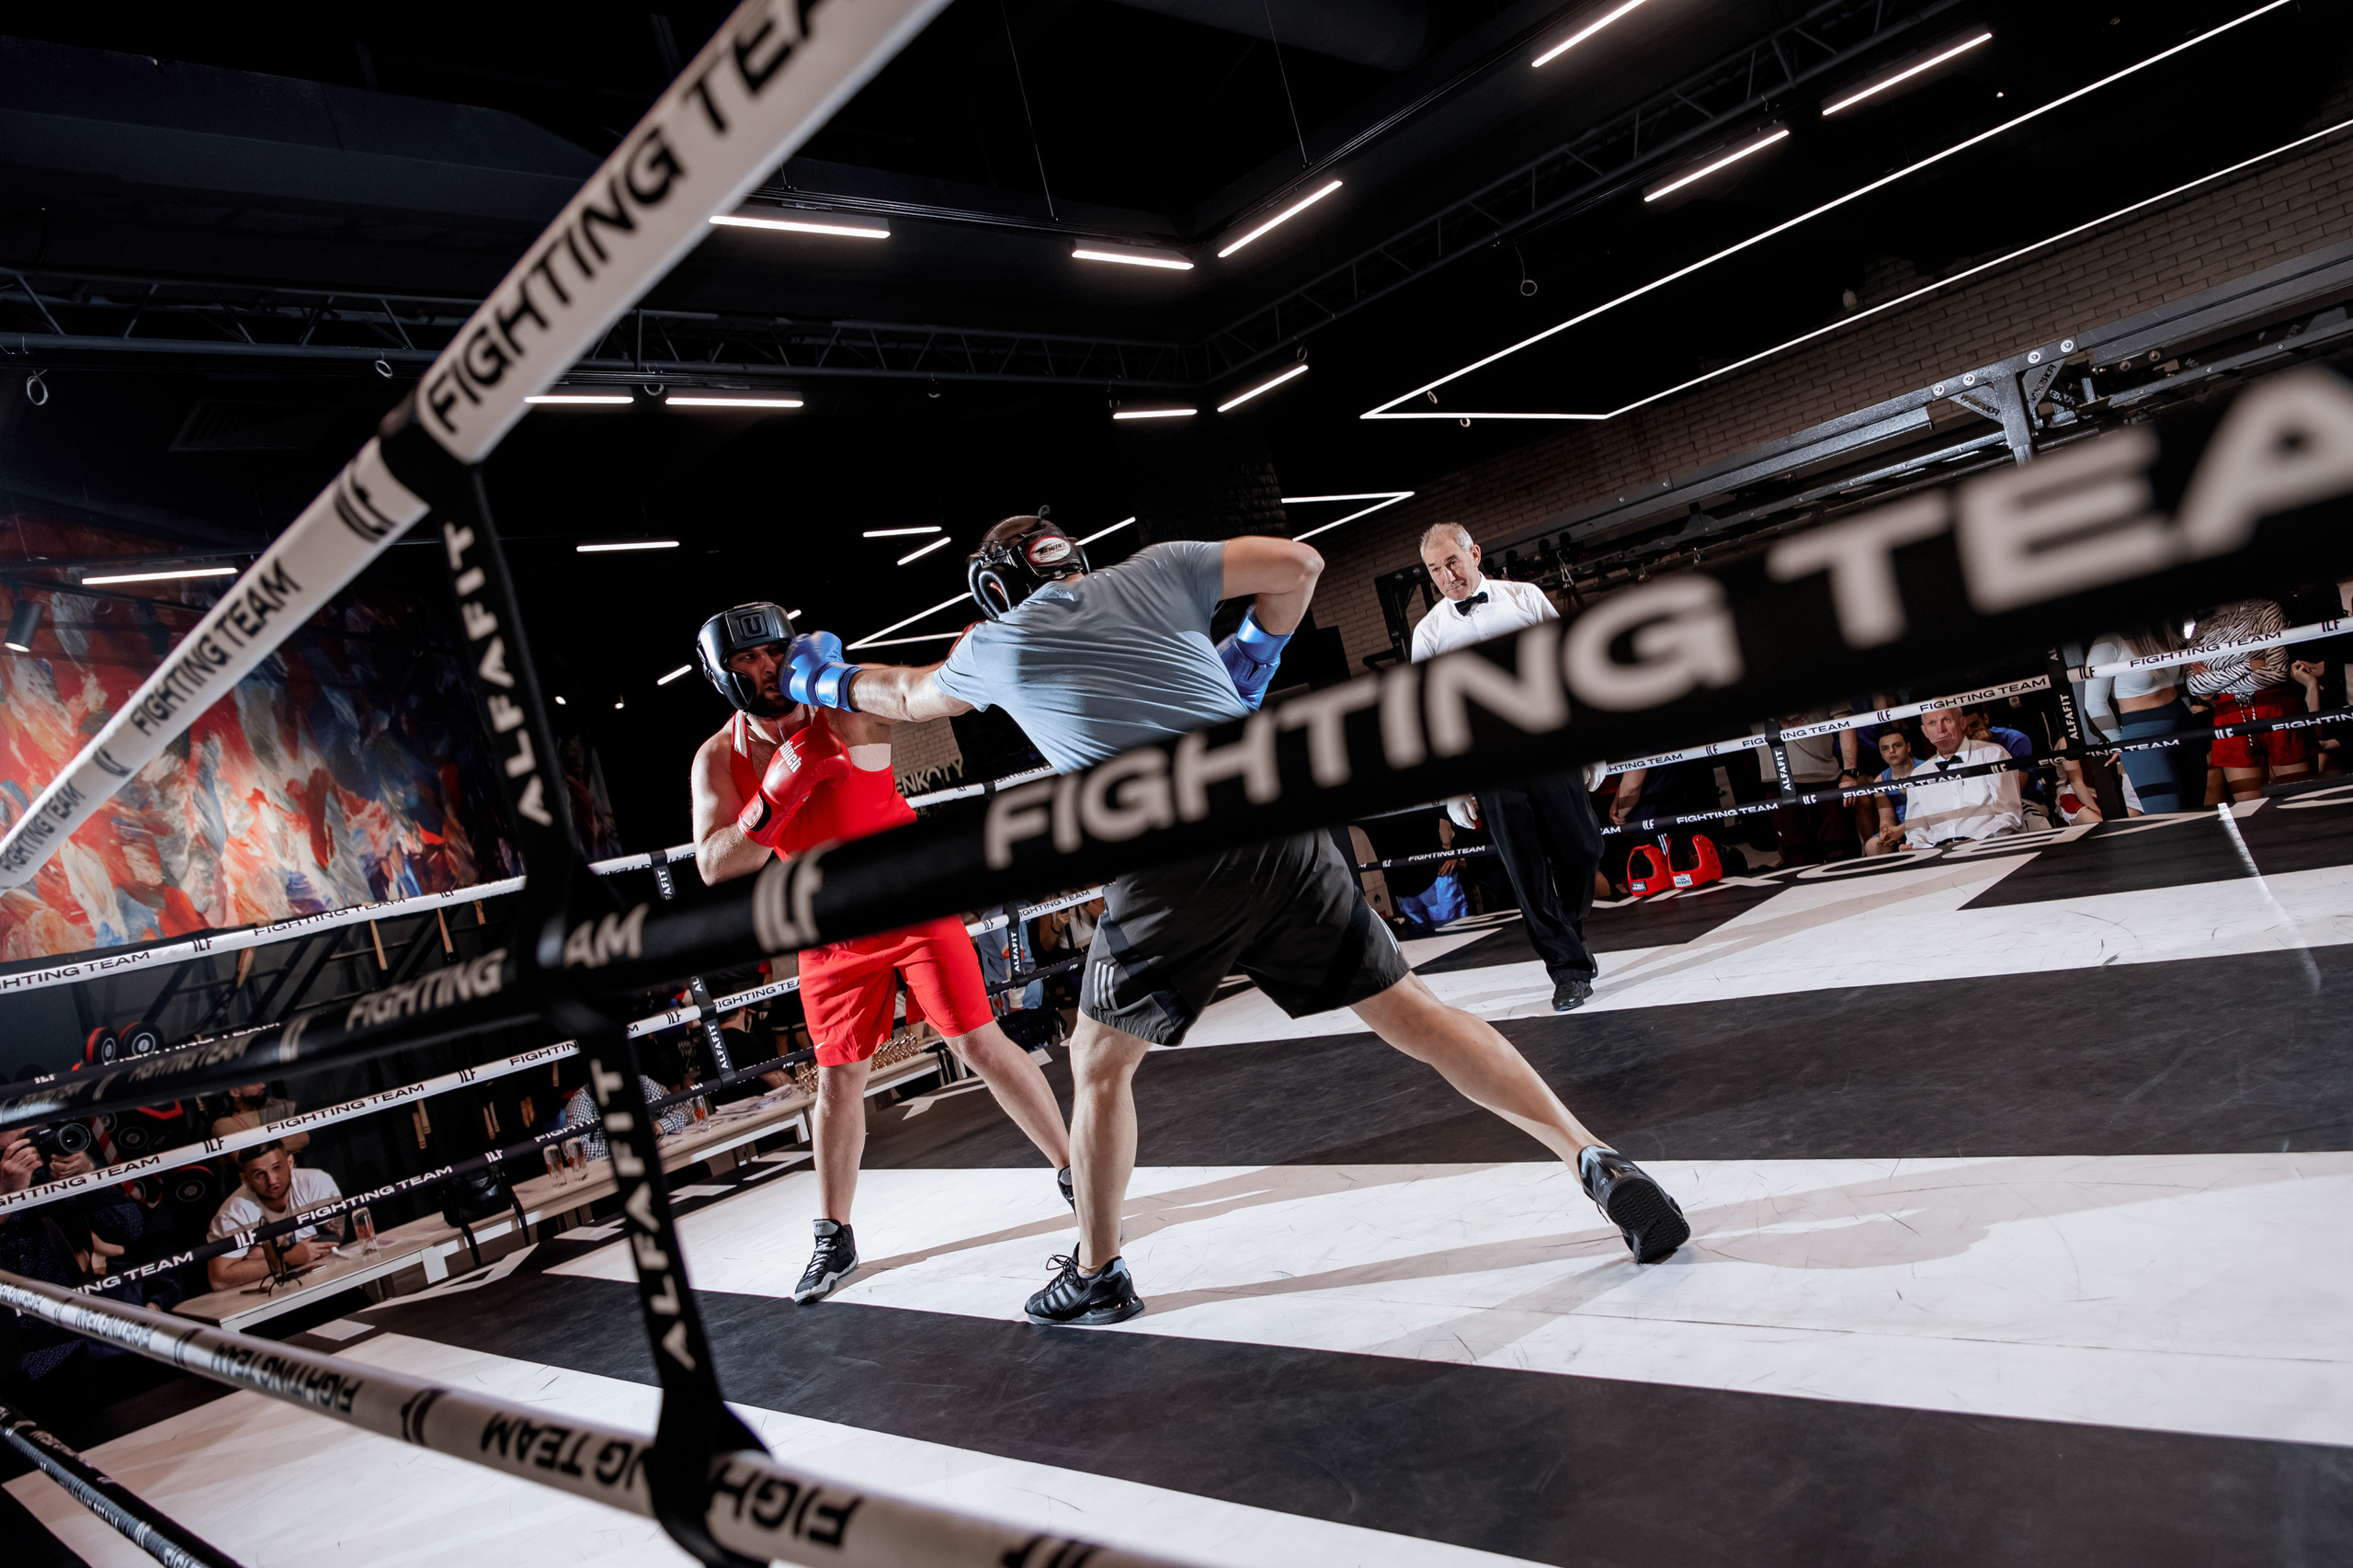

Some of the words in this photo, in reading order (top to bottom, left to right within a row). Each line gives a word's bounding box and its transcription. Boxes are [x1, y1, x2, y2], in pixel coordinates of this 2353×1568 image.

[422, 123, 688, 436] FIGHTING
[131, 632, 233, 736] FIGHTING
[213, 558, 302, 649] TEAM
[444, 521, 552, 826] ALFAFIT
[345, 949, 507, 1033] FIGHTING
[563, 903, 650, 969] AM
[985, 575, 1743, 869] FIGHTING
[1766, 369, 2353, 648] TEA
[1606, 759, 1645, 774] HTING
[1647, 753, 1683, 767] TEAM
[1809, 721, 1850, 734] TEAM
[1919, 689, 1995, 712] FIGHTING
[1998, 677, 2047, 694] TEAM
[2130, 643, 2221, 667] FIGHTING
[2224, 631, 2282, 649] TEAM
[2060, 694, 2079, 740] ALFAFIT
[40, 779, 86, 824] TEAM
[1676, 809, 1738, 824] FIGHTING
[1739, 802, 1779, 814] TEAM
[1842, 782, 1915, 799] FIGHTING
[1915, 774, 1962, 786] TEAM
[2124, 739, 2179, 752] TEAM
[2271, 712, 2353, 732] FIGHTI
[1774, 750, 1792, 790] ALFAFIT
[1408, 850, 1454, 862] FIGHTING
[1456, 846, 1485, 855] TEAM
[1019, 900, 1062, 917] IGHTING
[1063, 890, 1091, 903] TEAM
[0, 965, 81, 991] HTING
[87, 951, 151, 972] TEAM
[254, 910, 348, 936] FIGHTING
[1011, 932, 1021, 971] ALFAFIT
[708, 1025, 729, 1069] ALFAFIT
[0, 1176, 86, 1207] HTING
[90, 1155, 161, 1181] TEAM
[266, 1100, 366, 1133] FIGHTING
[368, 1084, 426, 1105] TEAM
[509, 1040, 578, 1066] FIGHTIN
[123, 1251, 194, 1280] TEAM
[296, 1185, 395, 1225] FIGHTING
[396, 1165, 454, 1192] TEAM
[590, 1058, 697, 1372] ALFAFIT
[210, 1342, 264, 1382] TEAM
[258, 1353, 363, 1415] FIGHTING
[480, 1412, 591, 1478] TEAM
